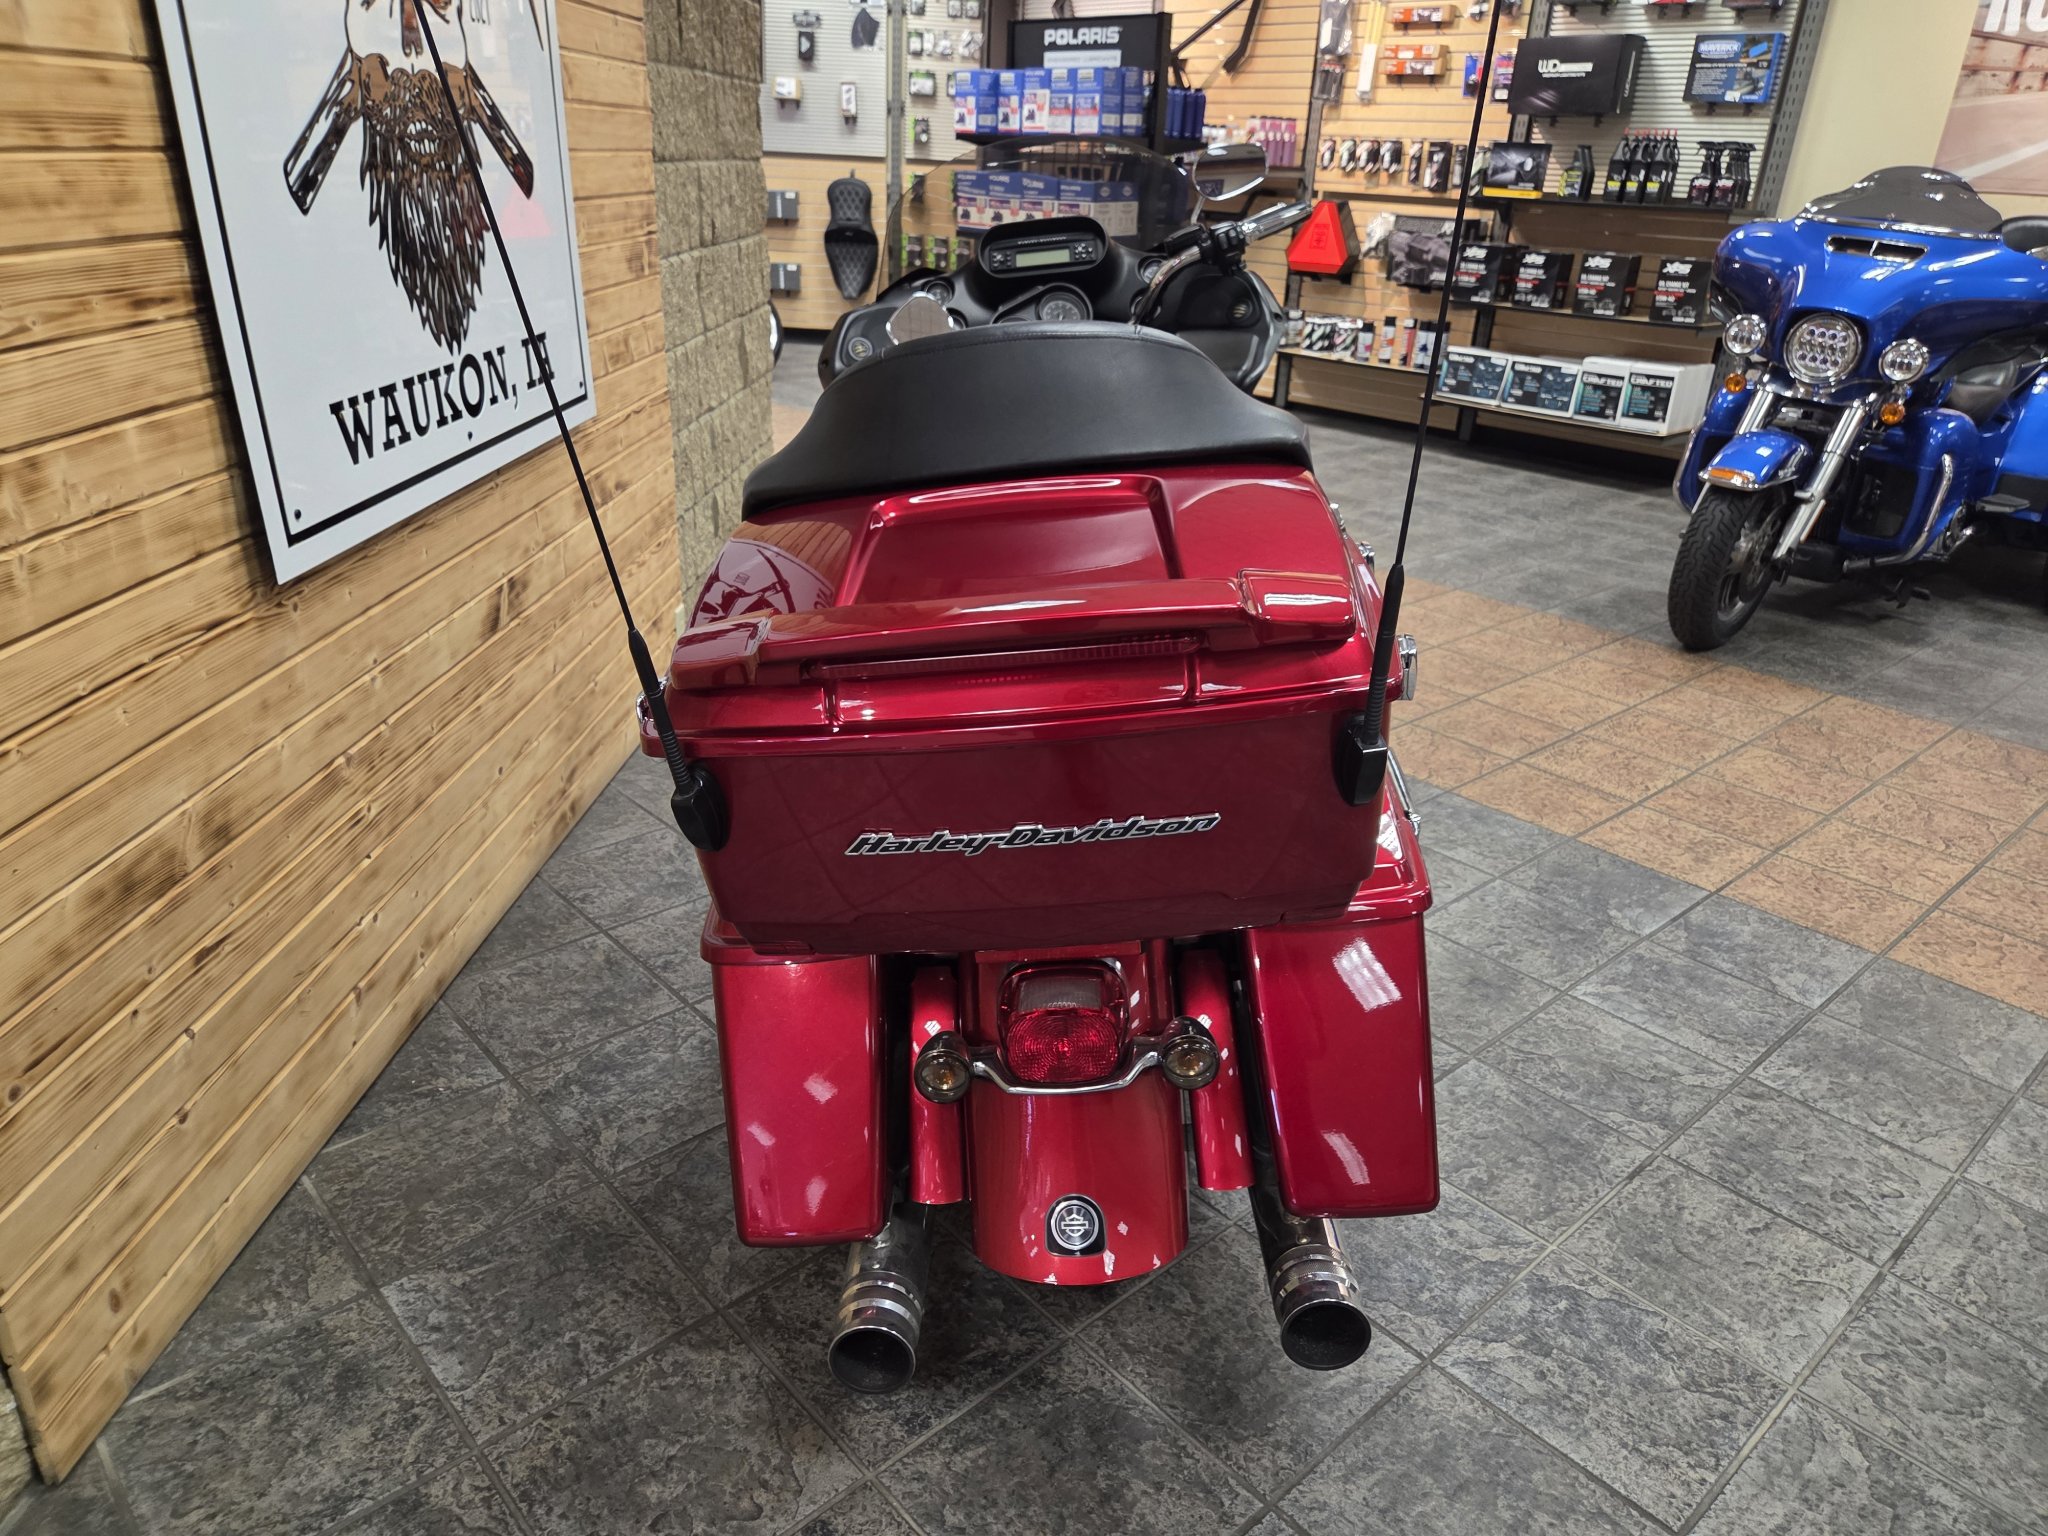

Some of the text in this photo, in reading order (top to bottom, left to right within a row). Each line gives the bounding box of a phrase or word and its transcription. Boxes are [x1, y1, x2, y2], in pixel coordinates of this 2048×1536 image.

[1044, 26, 1120, 46] POLARIS
[329, 346, 519, 466] WAUKON,
[845, 812, 1221, 856] Harley-Davidson
